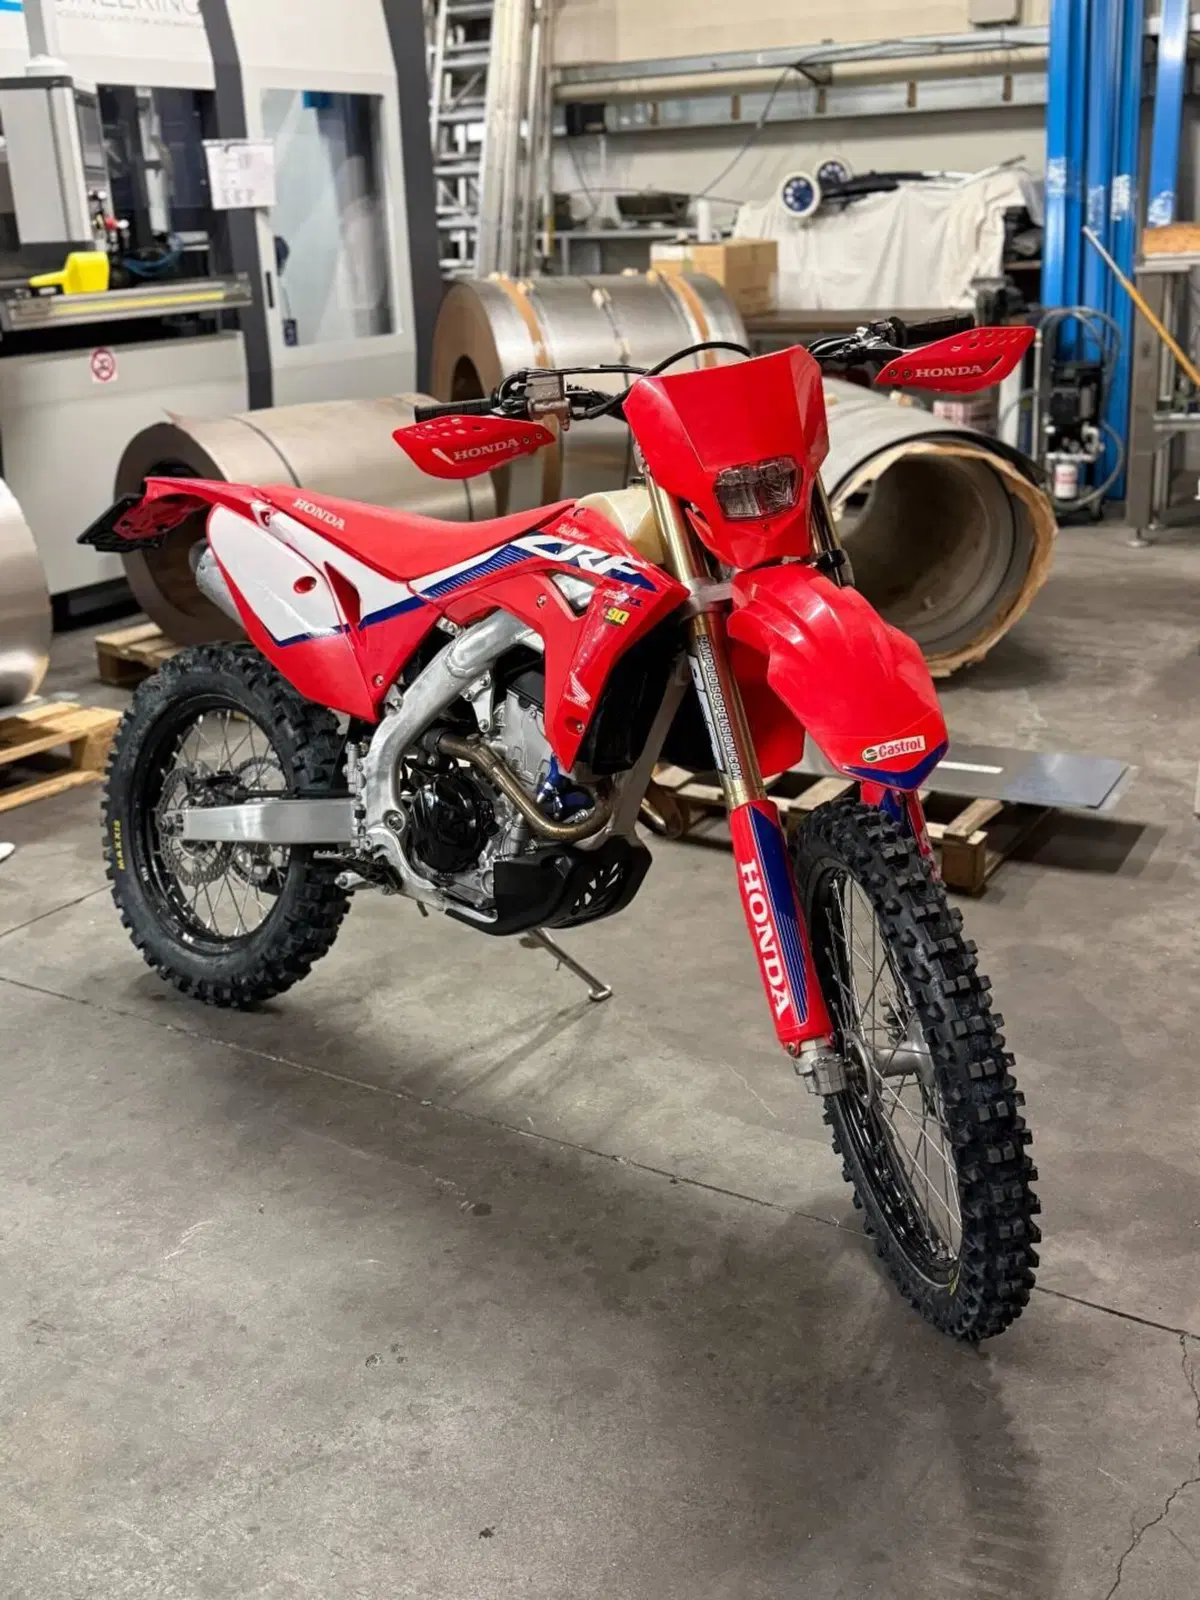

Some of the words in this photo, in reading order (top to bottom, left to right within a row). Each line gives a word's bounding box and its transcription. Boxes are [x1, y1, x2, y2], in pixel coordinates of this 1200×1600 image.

[915, 365, 984, 378] HONDA
[453, 438, 520, 461] HONDA
[292, 498, 346, 531] HONDA
[878, 738, 923, 758] Castrol
[113, 819, 126, 870] MAXXIS
[740, 859, 791, 1020] HONDA
